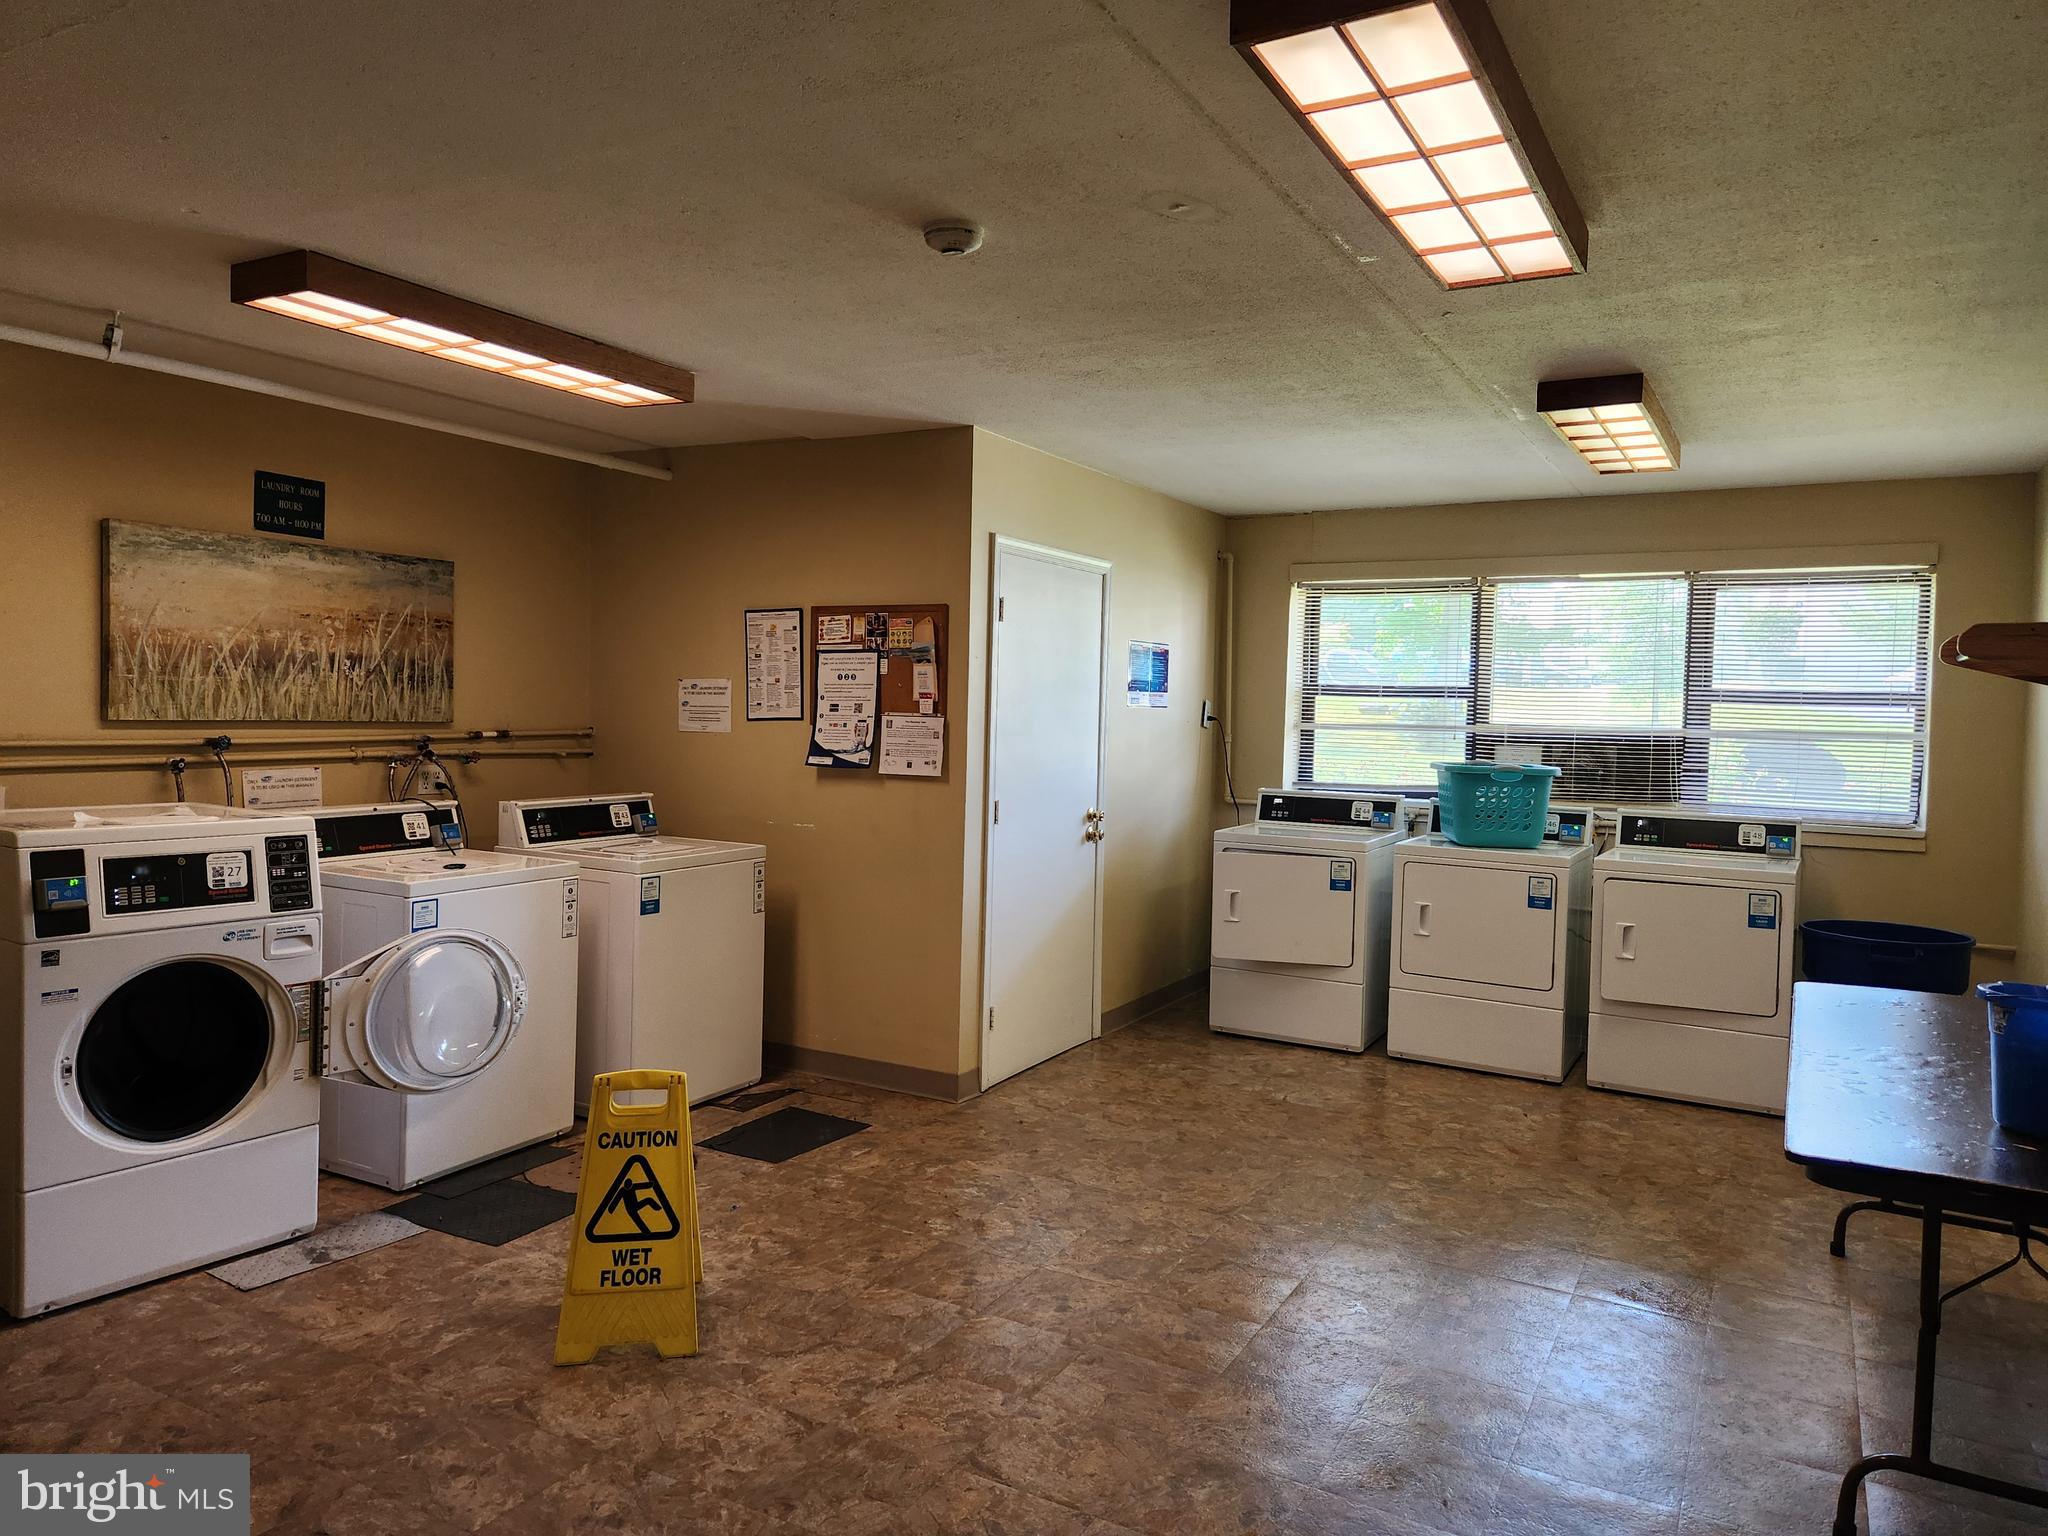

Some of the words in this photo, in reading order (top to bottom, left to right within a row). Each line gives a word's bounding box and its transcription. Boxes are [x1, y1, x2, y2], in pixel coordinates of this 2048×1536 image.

[261, 480, 295, 494] LAUNDRY
[300, 487, 320, 498] ROOM
[278, 500, 303, 511] HOURS
[416, 821, 426, 830] 41
[1547, 820, 1557, 828] 46
[227, 866, 242, 877] 27
[598, 1130, 678, 1149] CAUTION
[612, 1248, 652, 1266] WET
[600, 1267, 662, 1287] FLOOR
